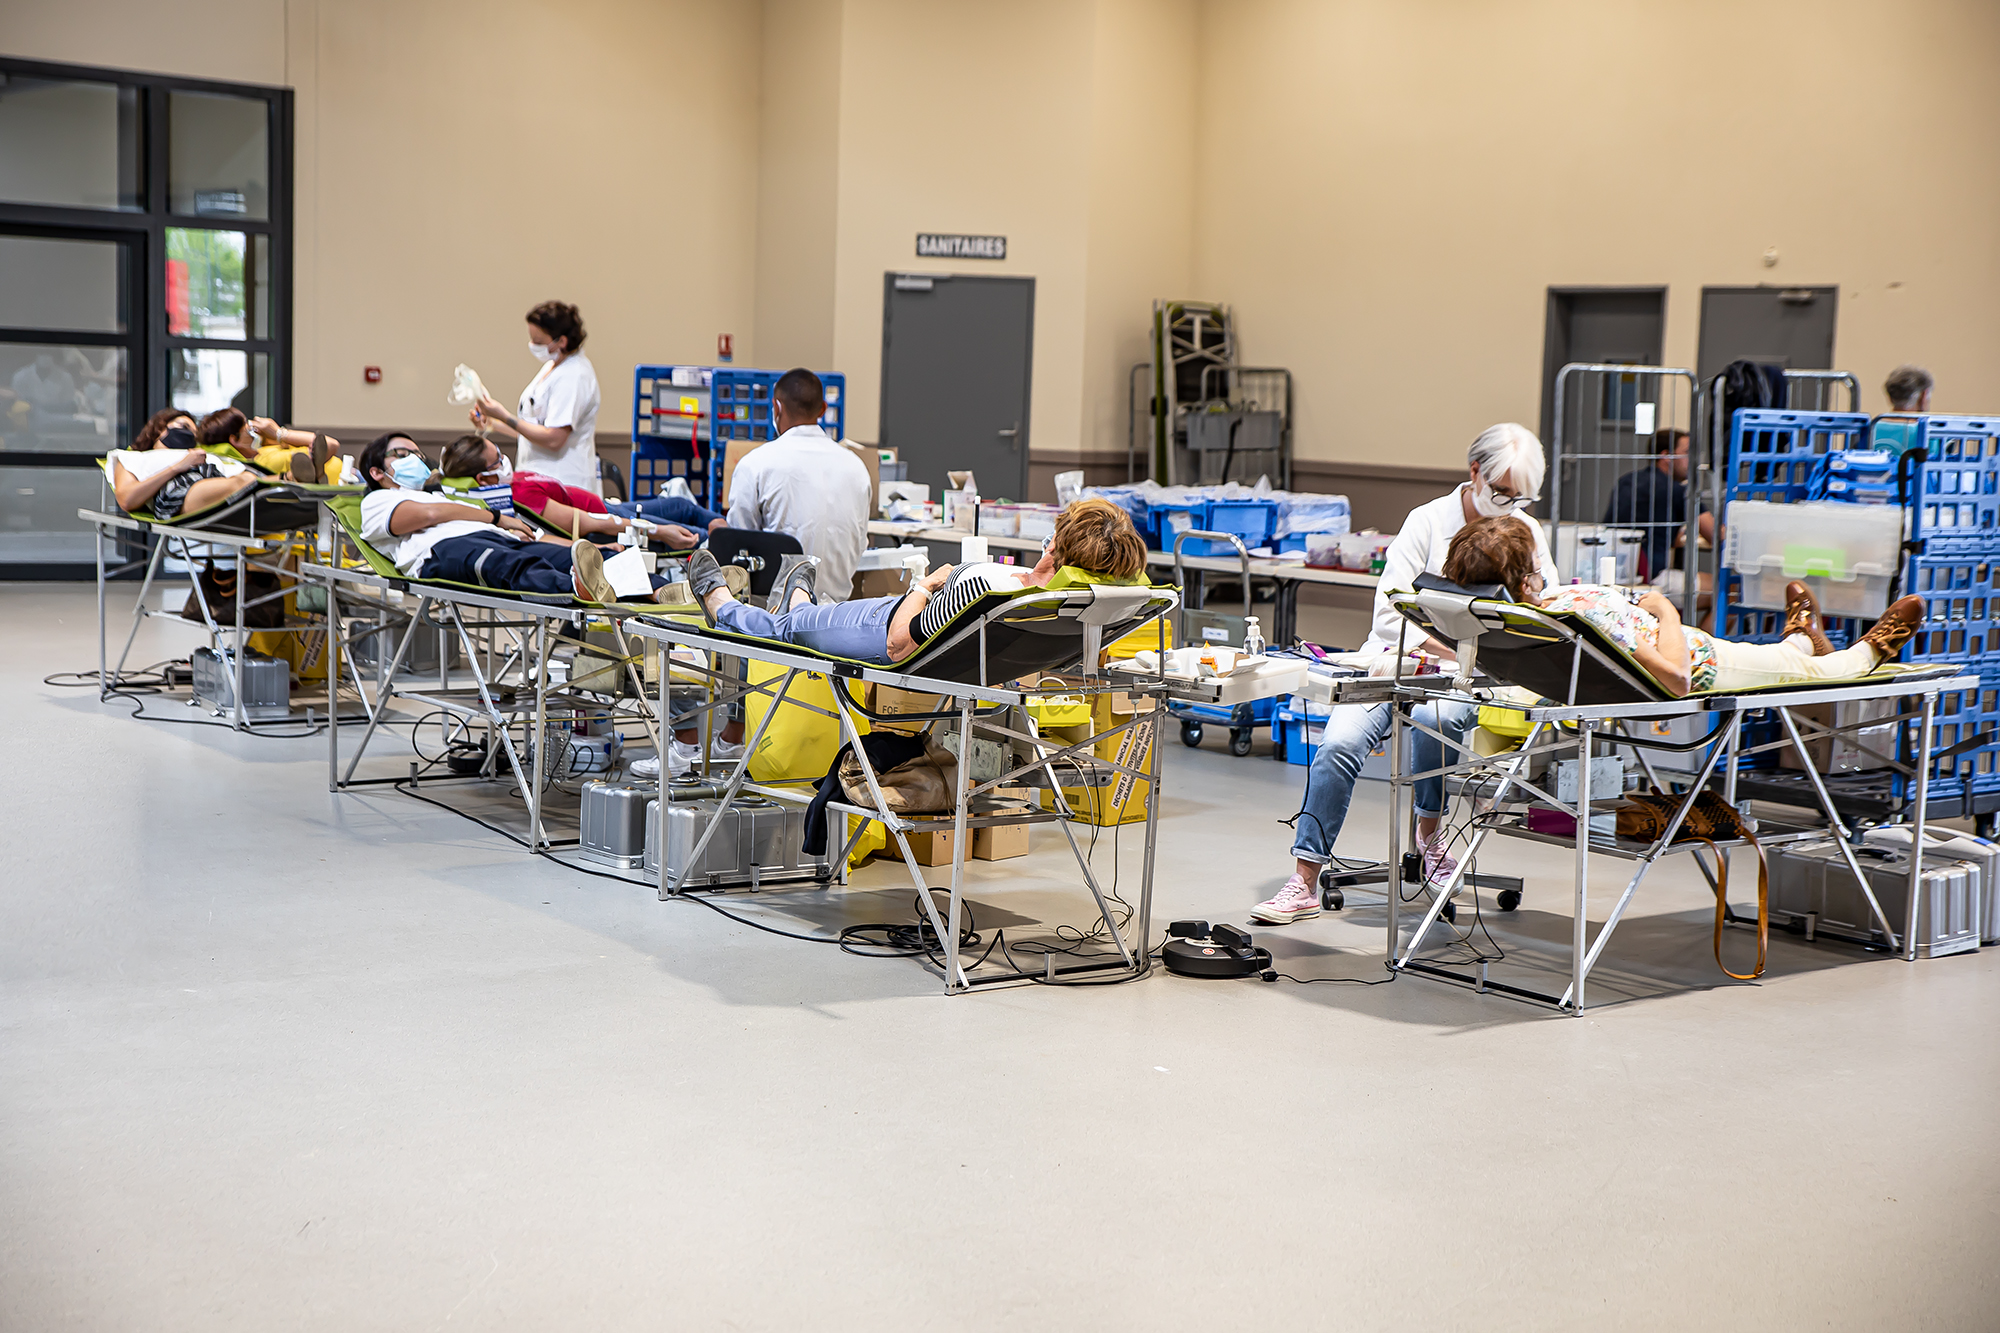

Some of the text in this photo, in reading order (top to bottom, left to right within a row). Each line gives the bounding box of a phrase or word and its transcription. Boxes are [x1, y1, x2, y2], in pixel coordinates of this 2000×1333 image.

[918, 236, 1005, 257] SANITAIRES
[1115, 741, 1129, 766] LINICAL
[1113, 781, 1126, 807] DECHETS
